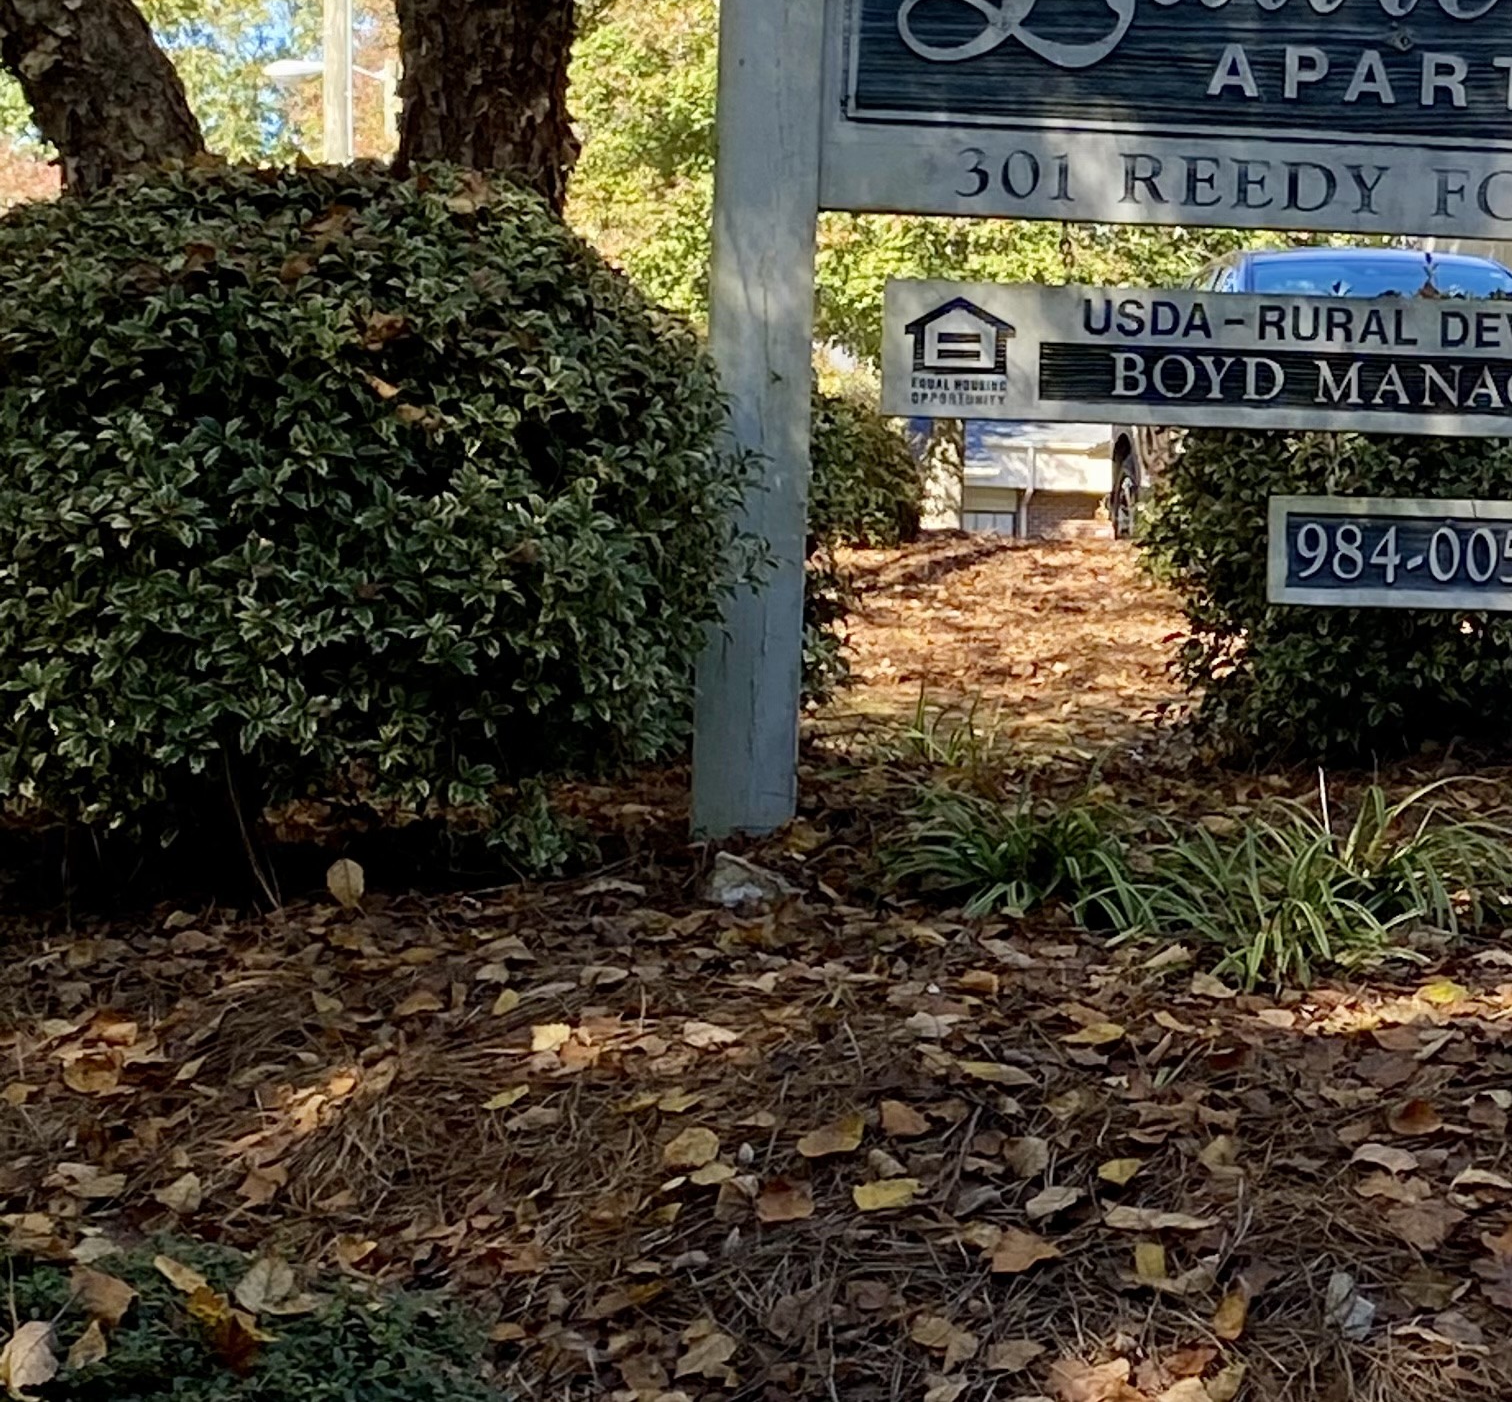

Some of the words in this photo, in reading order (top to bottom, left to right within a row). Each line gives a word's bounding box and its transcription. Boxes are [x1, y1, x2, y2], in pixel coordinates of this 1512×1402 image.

[955, 148, 1074, 203] 301
[1118, 151, 1389, 216] REEDY
[911, 377, 950, 391] EQUAL
[953, 379, 1007, 392] HOUSING
[1111, 351, 1286, 400] BOYD
[911, 392, 1006, 405] OPPORTUNITY
